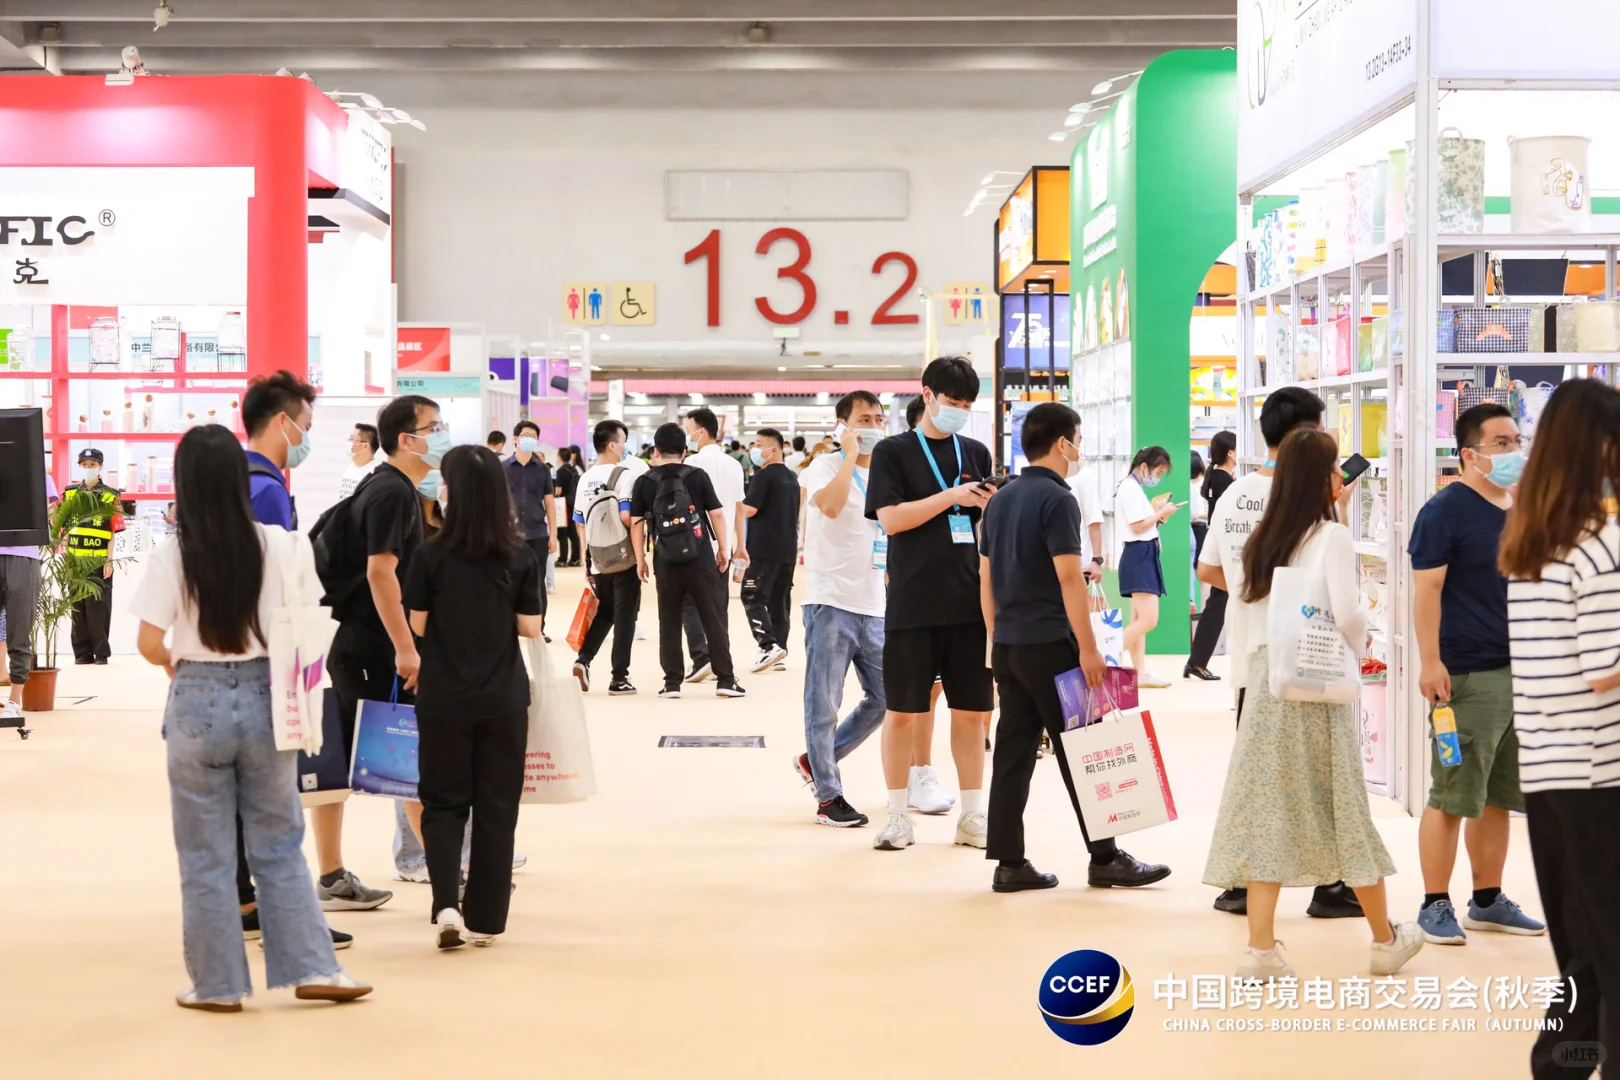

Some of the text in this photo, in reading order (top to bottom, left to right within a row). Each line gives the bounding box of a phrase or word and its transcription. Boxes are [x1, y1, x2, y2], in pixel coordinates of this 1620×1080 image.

[684, 227, 919, 327] 13.2
[1236, 494, 1264, 512] Cool
[1224, 518, 1252, 534] Break
[83, 538, 101, 547] BAO
[1082, 742, 1135, 764] 中国制造网
[546, 762, 555, 770] to
[1085, 753, 1138, 775] 帮你找外商
